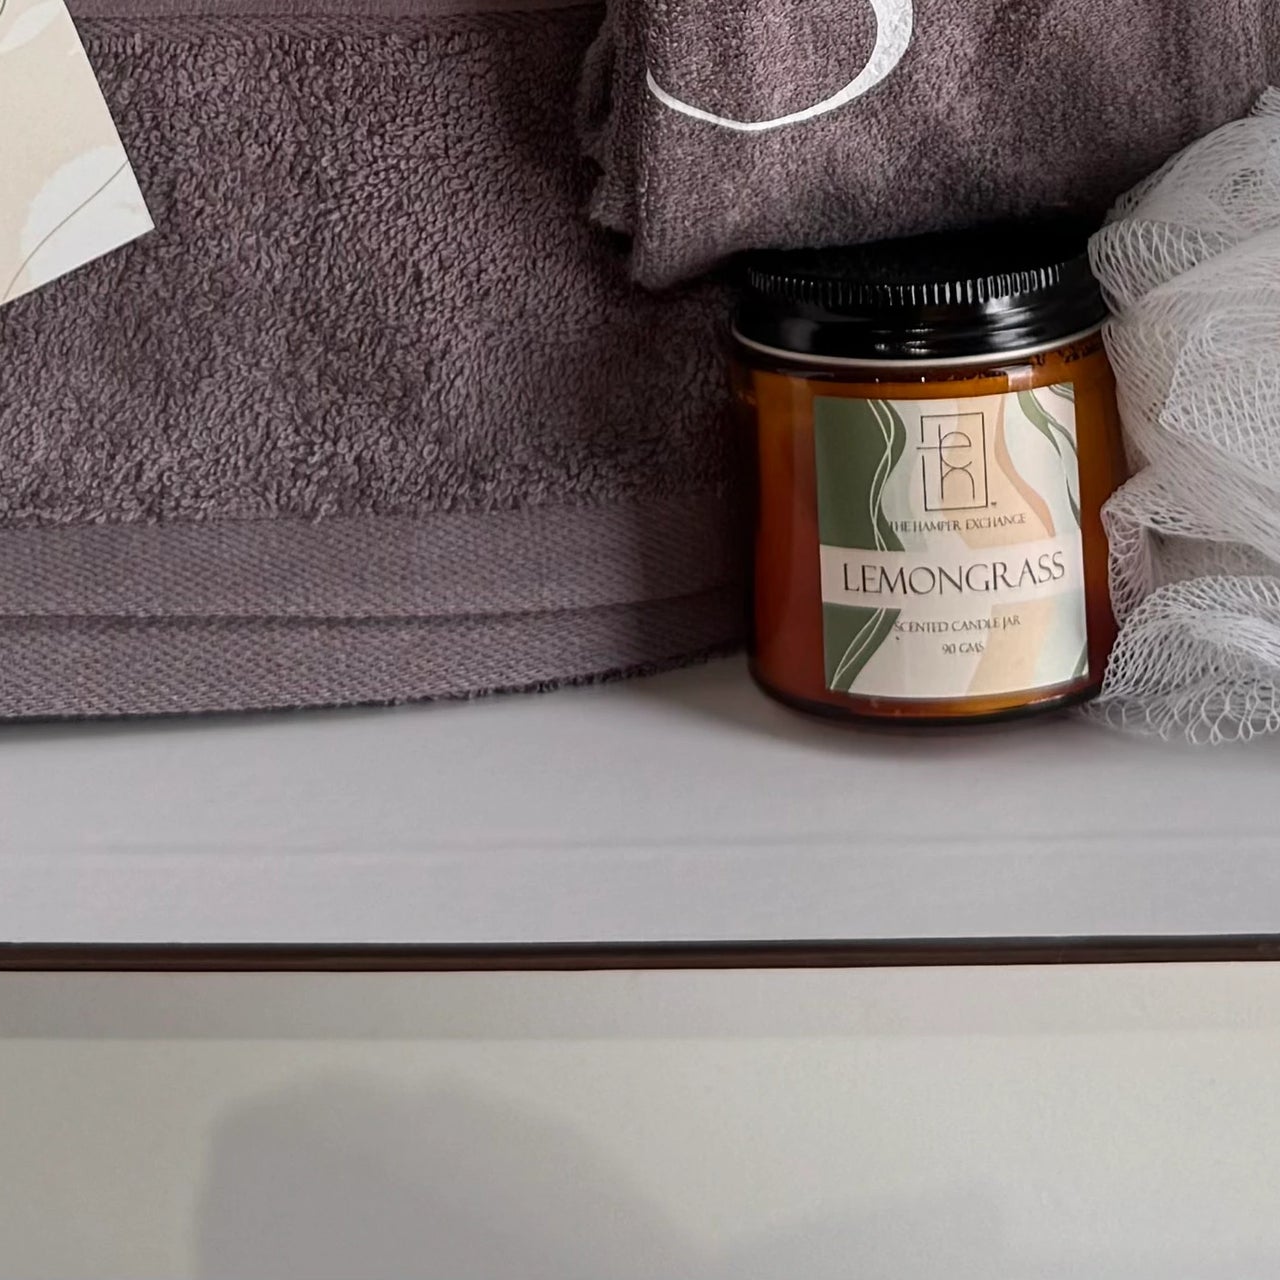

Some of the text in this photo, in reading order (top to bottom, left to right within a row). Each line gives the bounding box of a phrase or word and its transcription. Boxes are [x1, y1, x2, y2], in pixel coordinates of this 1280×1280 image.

[890, 513, 1026, 533] THE HAMPER EXCHANGE
[843, 551, 1066, 595] LEMONGRASS
[894, 614, 1022, 634] SCENTED CANDLE JAR
